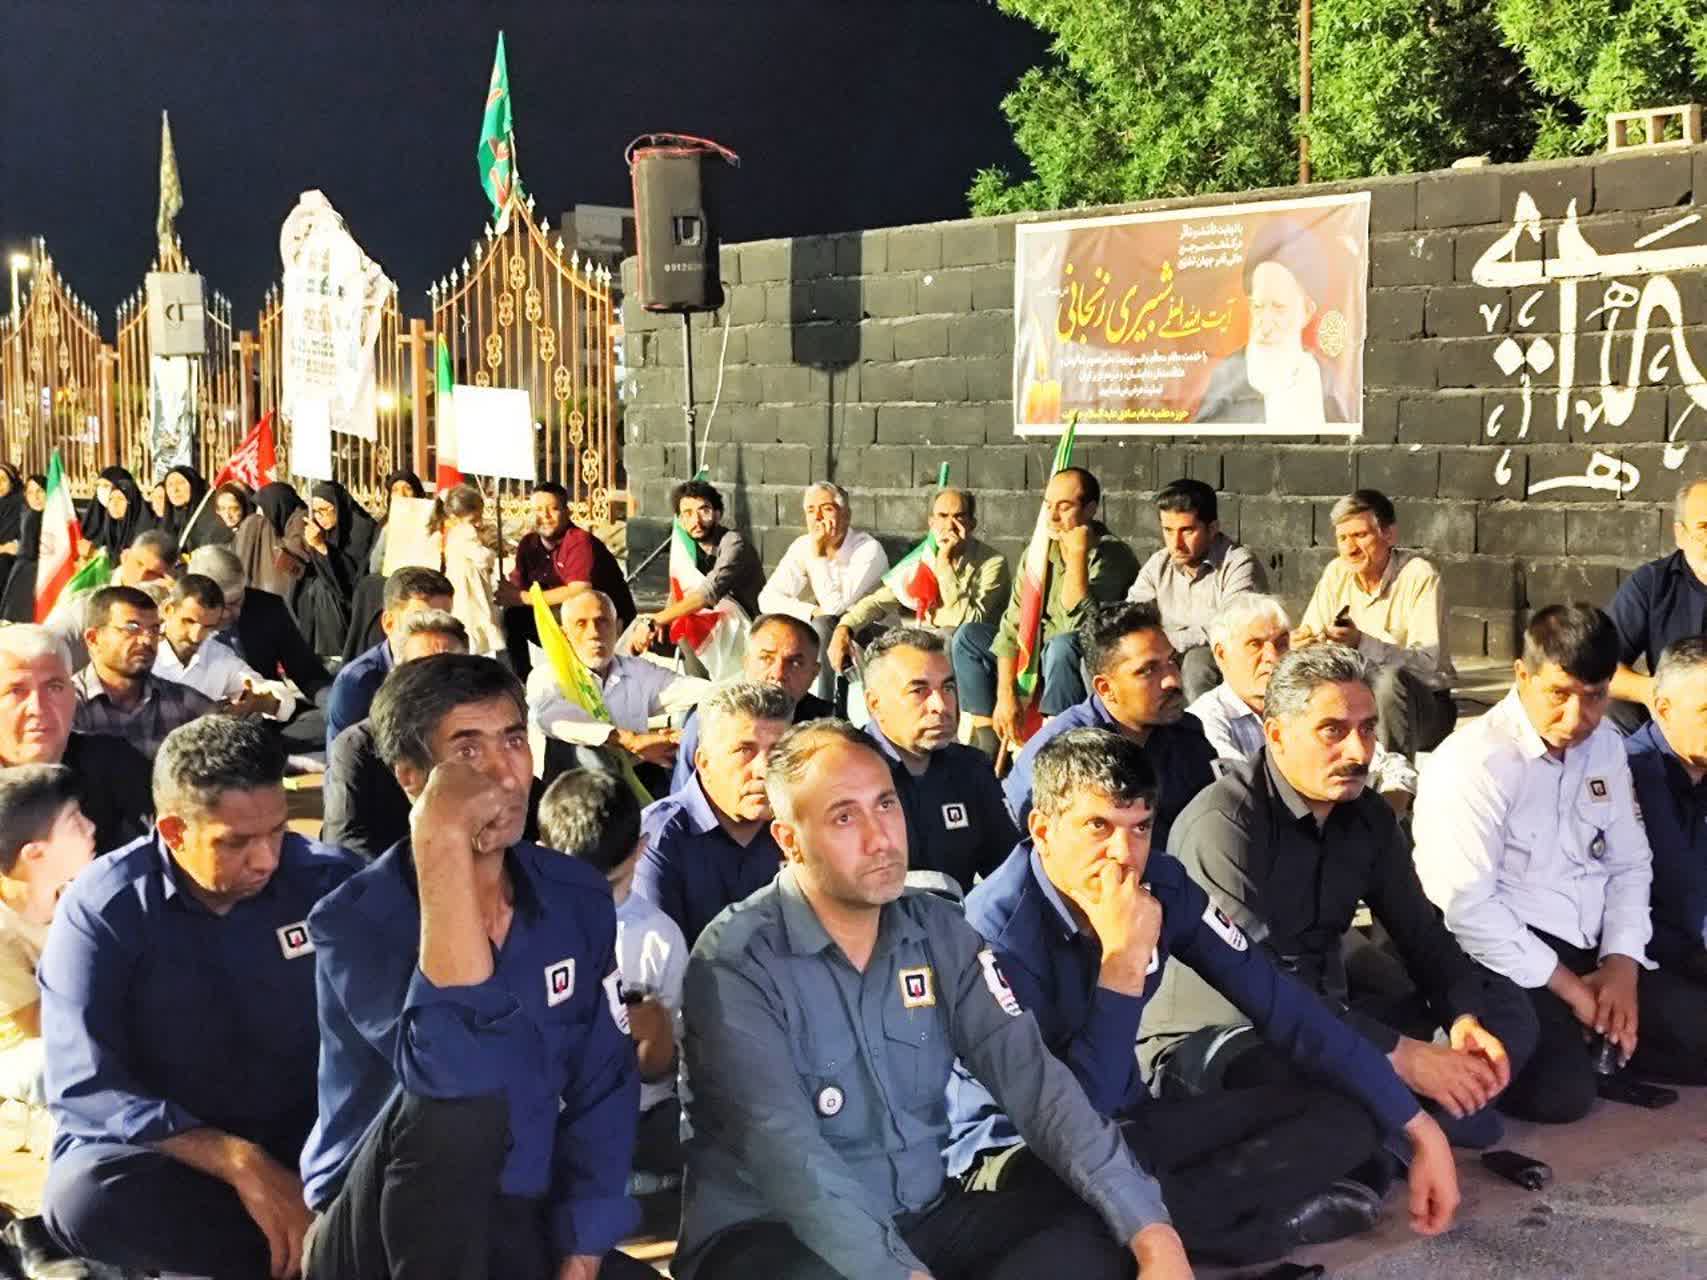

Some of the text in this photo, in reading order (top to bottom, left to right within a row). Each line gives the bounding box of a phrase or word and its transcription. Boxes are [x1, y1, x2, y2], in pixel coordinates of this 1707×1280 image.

[1056, 263, 1110, 344] زنجانی
[1104, 260, 1173, 344] شبیری
[1201, 297, 1239, 335] آیت
